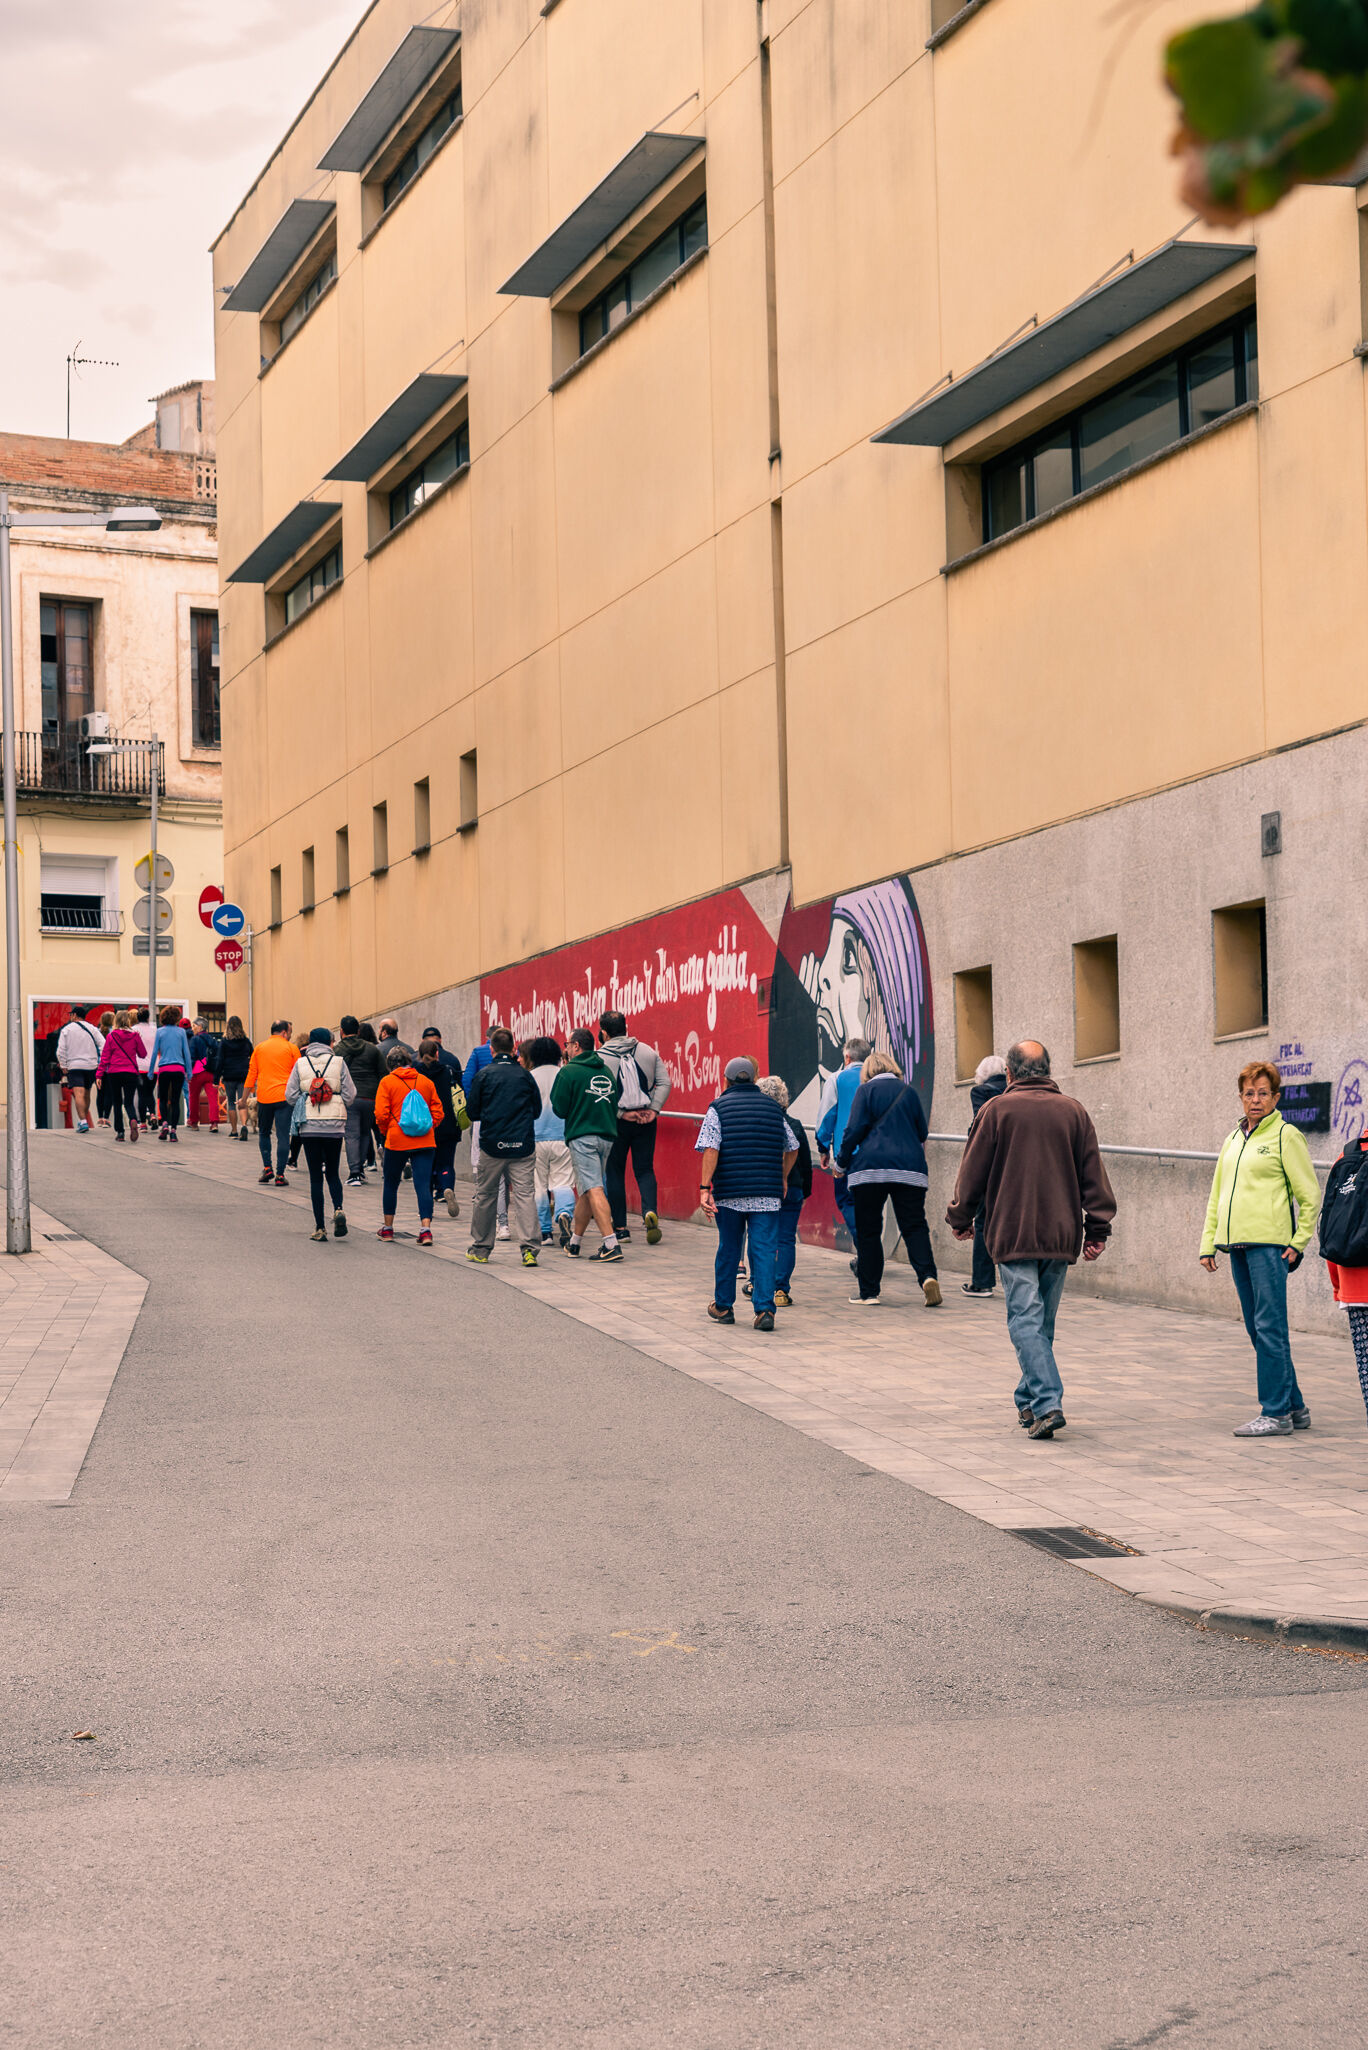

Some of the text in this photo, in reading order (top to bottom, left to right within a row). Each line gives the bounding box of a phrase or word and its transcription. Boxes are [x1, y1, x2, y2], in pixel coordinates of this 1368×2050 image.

[216, 951, 242, 961] STOP
[572, 966, 607, 1029] poden
[610, 959, 654, 1016] tancar
[655, 947, 678, 1004] dins
[679, 953, 704, 996] una
[685, 1030, 722, 1099] Roig
[1277, 1062, 1313, 1077] ATRIARCAT
